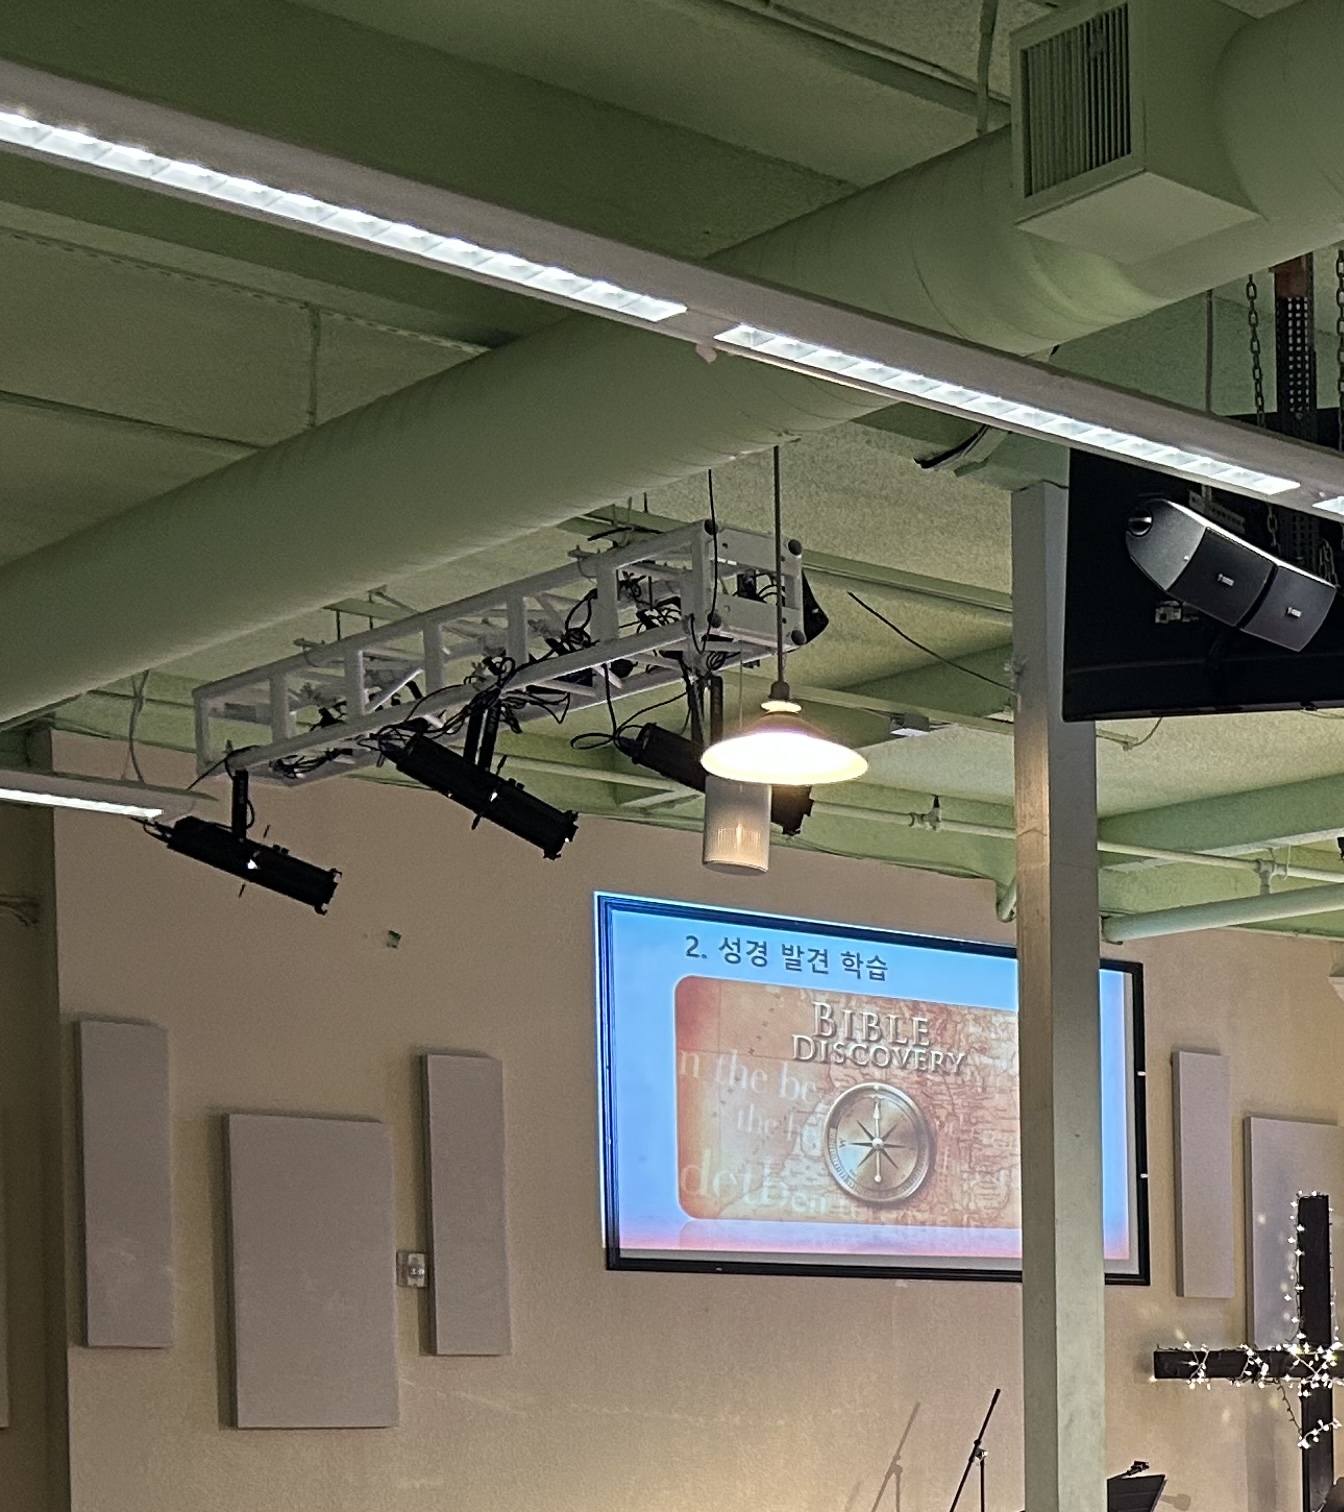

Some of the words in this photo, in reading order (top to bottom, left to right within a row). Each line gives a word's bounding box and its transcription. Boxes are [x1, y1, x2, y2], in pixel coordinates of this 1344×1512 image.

[685, 935, 708, 959] 2.
[718, 936, 769, 968] 성경
[781, 943, 830, 975] 발견
[841, 951, 889, 982] 학습
[811, 1001, 932, 1048] BIBLE
[791, 1033, 967, 1077] DISCOVERY
